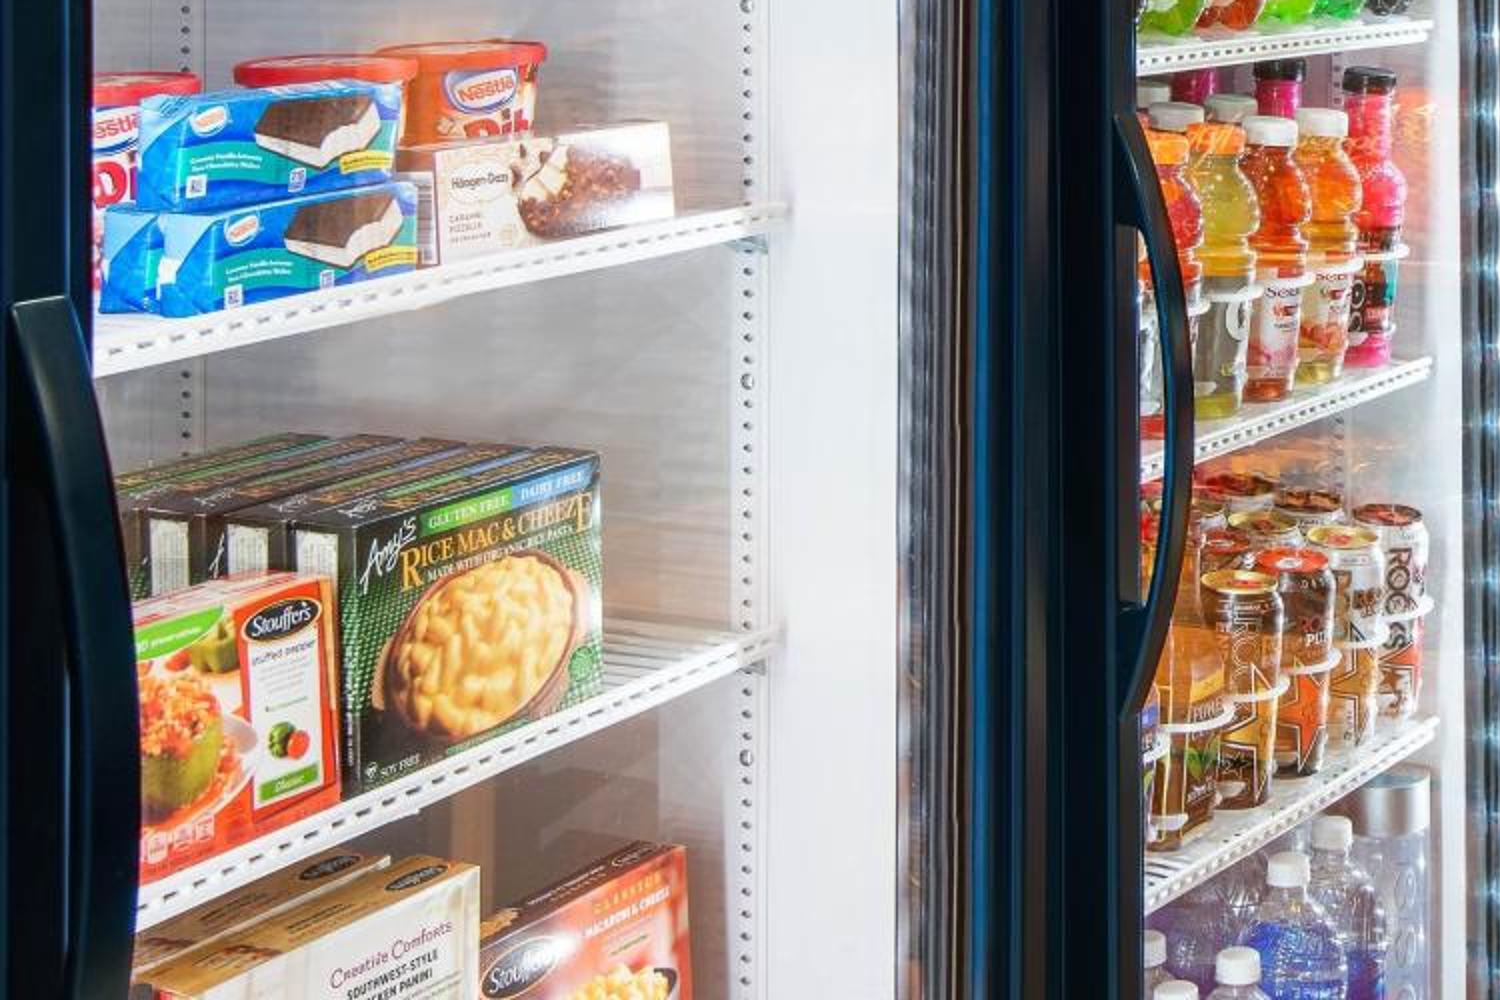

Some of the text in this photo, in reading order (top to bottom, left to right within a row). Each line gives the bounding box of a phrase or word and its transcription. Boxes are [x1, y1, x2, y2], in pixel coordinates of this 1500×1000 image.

[400, 537, 454, 592] RICE
[456, 521, 500, 557] MAC
[502, 517, 518, 540] &
[251, 601, 312, 637] Stouffer's
[330, 921, 453, 989] Creative Comforts
[347, 949, 439, 1000] SOUTHWEST-STYLE
